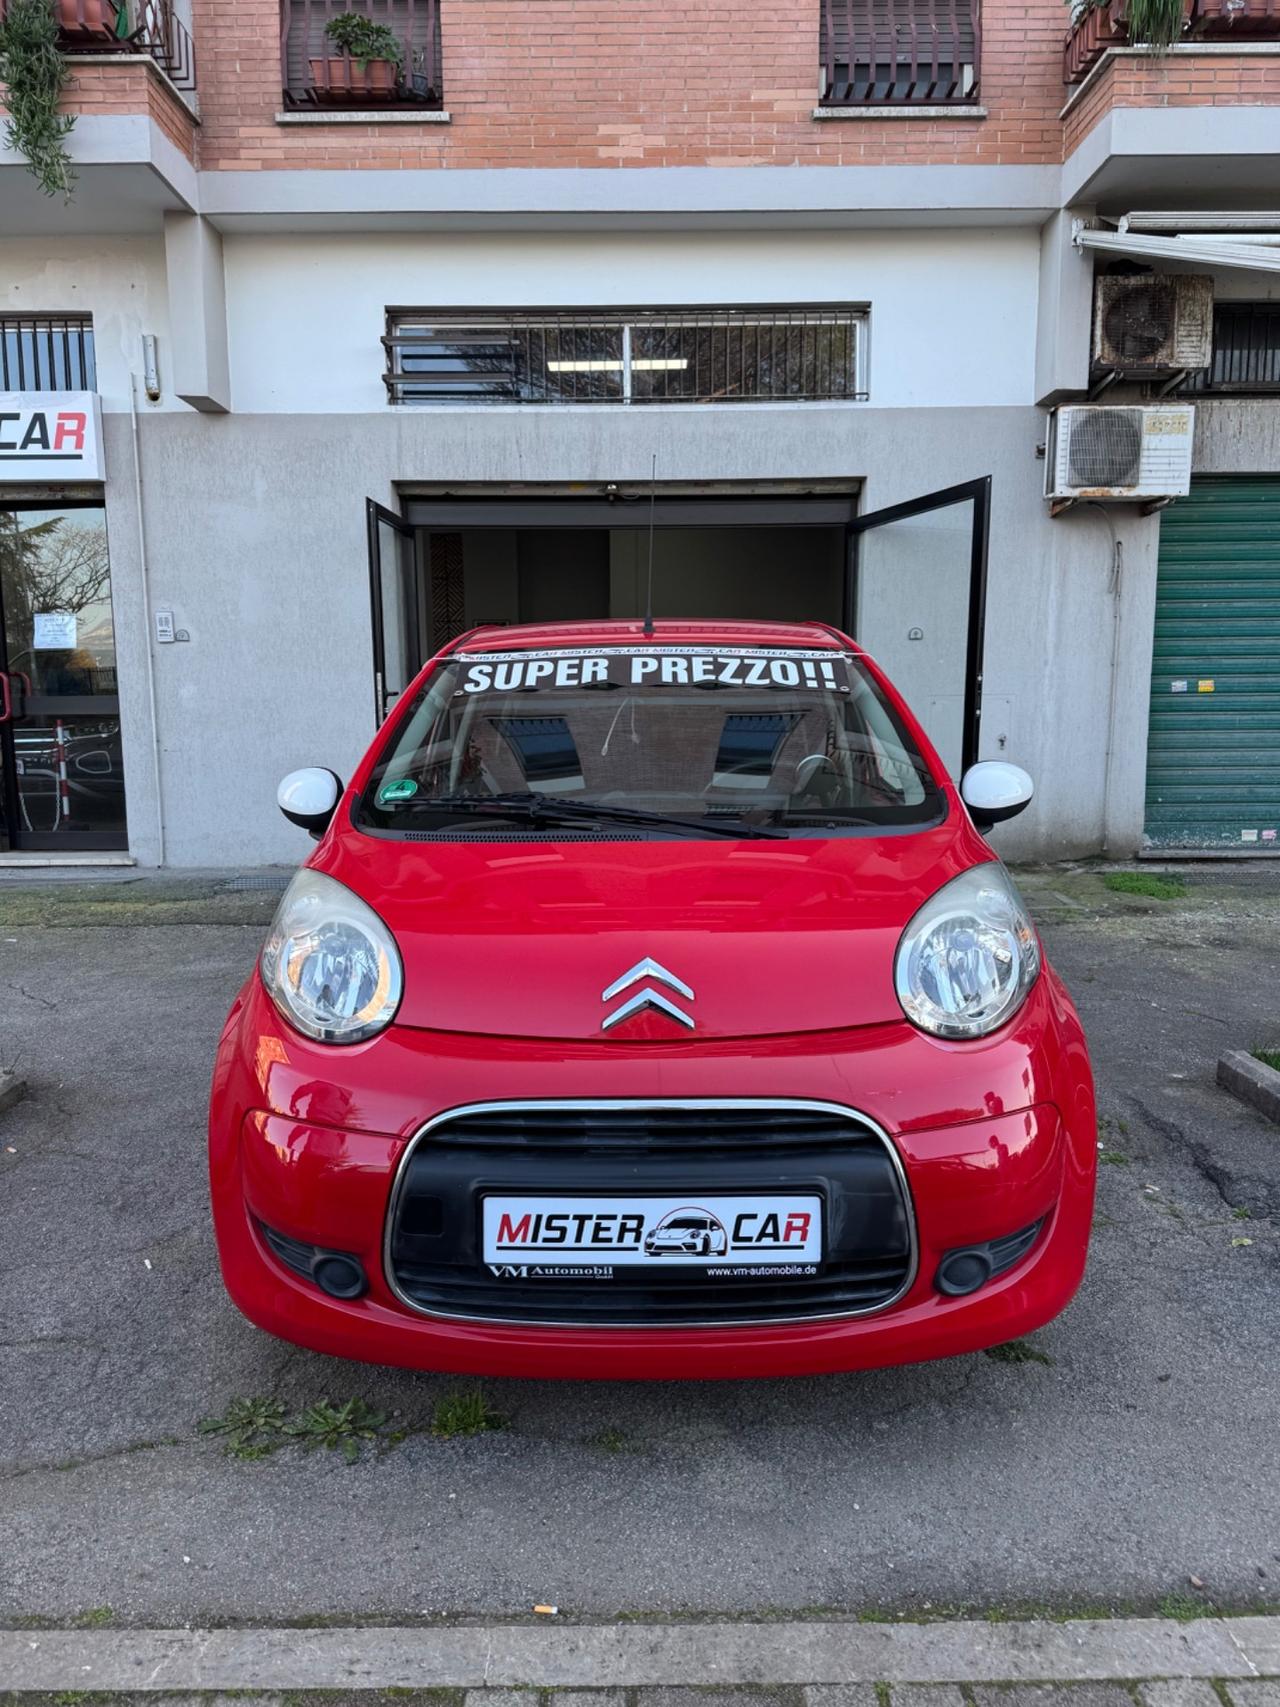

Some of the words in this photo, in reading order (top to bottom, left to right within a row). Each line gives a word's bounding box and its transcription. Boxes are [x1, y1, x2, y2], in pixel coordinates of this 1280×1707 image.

[0, 412, 87, 450] CAR
[463, 659, 609, 693] SUPER
[631, 656, 837, 689] PREZZO!!
[496, 1213, 646, 1244] MISTER
[731, 1213, 812, 1244] CAR
[488, 1265, 528, 1278] VM
[530, 1266, 613, 1276] Automobil
[707, 1265, 817, 1277] www.vm-automobile.de
